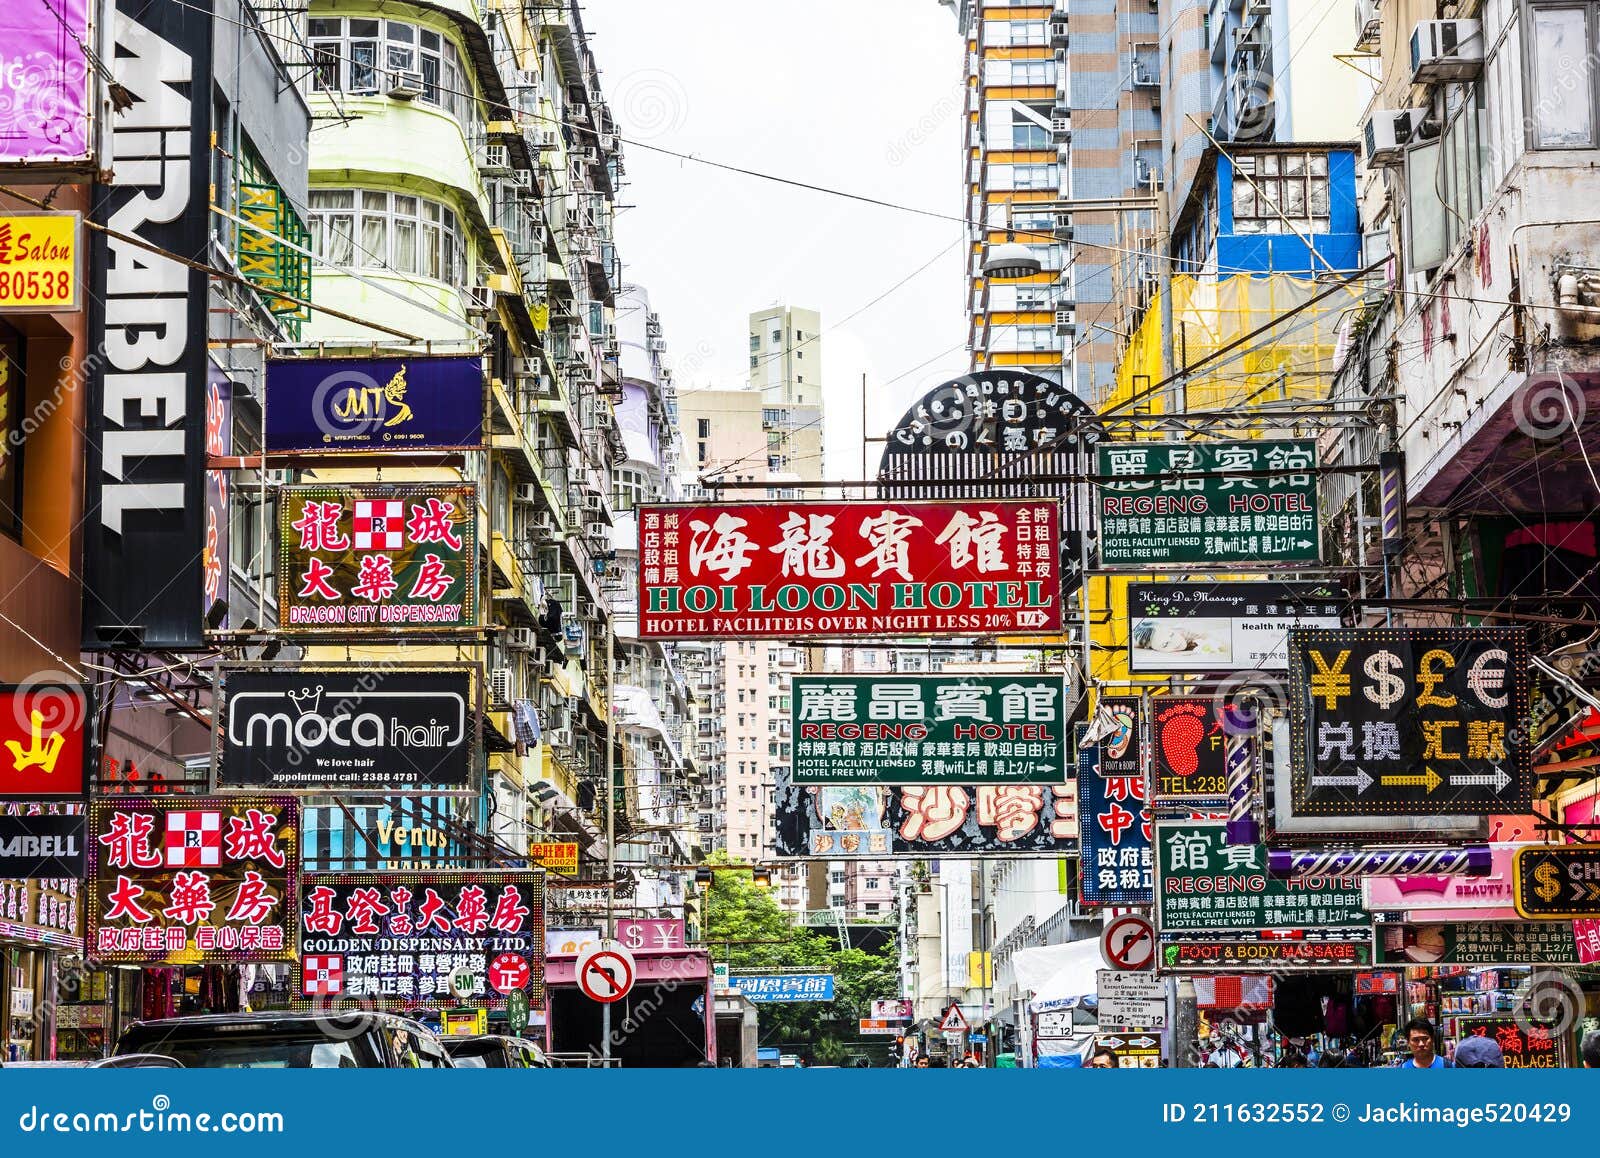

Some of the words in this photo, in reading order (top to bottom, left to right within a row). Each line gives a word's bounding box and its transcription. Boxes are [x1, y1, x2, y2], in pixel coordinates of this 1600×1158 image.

[14, 233, 71, 261] Salon
[101, 6, 193, 536] MIRABELL
[1106, 445, 1314, 491] 麗晶賓館
[1103, 495, 1209, 516] REGENG
[1228, 493, 1313, 513] HOTEL
[291, 499, 350, 551] 龍
[407, 497, 462, 550] 城
[1104, 518, 1151, 535] 持牌賓館
[1154, 517, 1202, 533] 酒店設備
[1204, 516, 1252, 533] 豪華套房
[1254, 515, 1313, 531] 歡迎自由行
[644, 513, 660, 584] 酒店設備
[663, 513, 680, 584] 純粹租房
[689, 509, 1010, 582] 海龍賓館
[1015, 507, 1033, 578] 全日特平
[1034, 507, 1051, 578] 時租過夜
[1105, 538, 1131, 547] HOTEL
[1132, 538, 1166, 547] FACILITY
[1168, 536, 1200, 546] LIENSED
[1105, 549, 1131, 558] HOTEL
[1132, 549, 1151, 557] FREE
[1152, 548, 1170, 557] WIFI
[298, 553, 455, 601] 大藥房
[645, 585, 738, 613] HOI
[748, 582, 881, 612] LOON
[891, 581, 1052, 610] HOTEL
[1172, 590, 1191, 602] Da
[1193, 590, 1246, 605] Massage
[290, 606, 346, 624] DRAGON
[347, 605, 377, 622] CITY
[379, 604, 462, 622] DISPENSARY
[646, 619, 709, 633] HOTEL
[712, 617, 814, 632] FACILITEIS
[818, 616, 869, 630] OVER
[872, 615, 932, 629] NIGHT
[935, 614, 981, 629] LESS
[985, 614, 1012, 628] 20%
[797, 682, 1058, 722] 麗晶賓館
[245, 712, 385, 747] moca
[390, 717, 450, 747] hair
[800, 723, 928, 740] REGENG
[953, 723, 1055, 740] HOTEL
[797, 741, 856, 757] 持牌賓館
[859, 741, 919, 757] 酒店設備
[922, 741, 980, 757] 豪華套房
[983, 741, 1057, 757] 歡迎自由行
[316, 758, 330, 767] We
[331, 757, 353, 767] love
[354, 757, 375, 767] hair
[797, 759, 831, 768] HOTEL
[832, 759, 874, 768] FACILITY
[875, 759, 916, 768] LIENSED
[1105, 761, 1118, 771] FOOT
[273, 773, 337, 783] appointment
[339, 772, 361, 782] call:
[362, 773, 391, 782] 2388
[392, 773, 418, 782] 4781
[797, 768, 831, 777] HOTEL
[832, 768, 855, 777] FREE
[856, 768, 878, 777] WIFI
[100, 811, 162, 868] 龍
[224, 809, 285, 868] 城
[376, 819, 447, 848] Venus
[532, 858, 577, 866] 7600029
[1165, 874, 1266, 894] REGENG
[1455, 884, 1503, 896] BEAUTY
[104, 871, 278, 925] 大藥房
[1165, 897, 1211, 911] 持牌賓館
[1214, 896, 1260, 909] 酒店設備
[1263, 895, 1308, 908] 豪華套房
[1166, 911, 1191, 919] HOTEL
[1191, 911, 1224, 919] FACILITY
[1225, 910, 1256, 918] LIENSED
[1166, 919, 1203, 927] HOTEL
[1231, 918, 1256, 926] WIFI
[98, 926, 187, 950] 政府註冊
[195, 926, 284, 950] 信心保證
[303, 938, 374, 952] GOLDEN
[379, 937, 486, 951] DISPENSARY
[493, 937, 531, 951] LTD.
[1179, 945, 1222, 959] FOOT
[1237, 945, 1279, 959] BODY
[1282, 945, 1356, 958] MASSAGE
[1456, 953, 1498, 962] HOTEL
[1506, 953, 1541, 961] FREE
[1546, 953, 1574, 961] WIFI
[347, 954, 414, 973] 政府註冊
[346, 976, 414, 995] 老牌正藥
[455, 974, 475, 990] 5M
[1150, 973, 1161, 983] 12
[1059, 1013, 1066, 1022] 7
[1151, 1016, 1164, 1025] 12
[1060, 1027, 1071, 1036] 12
[1503, 1054, 1556, 1068] PALACE
